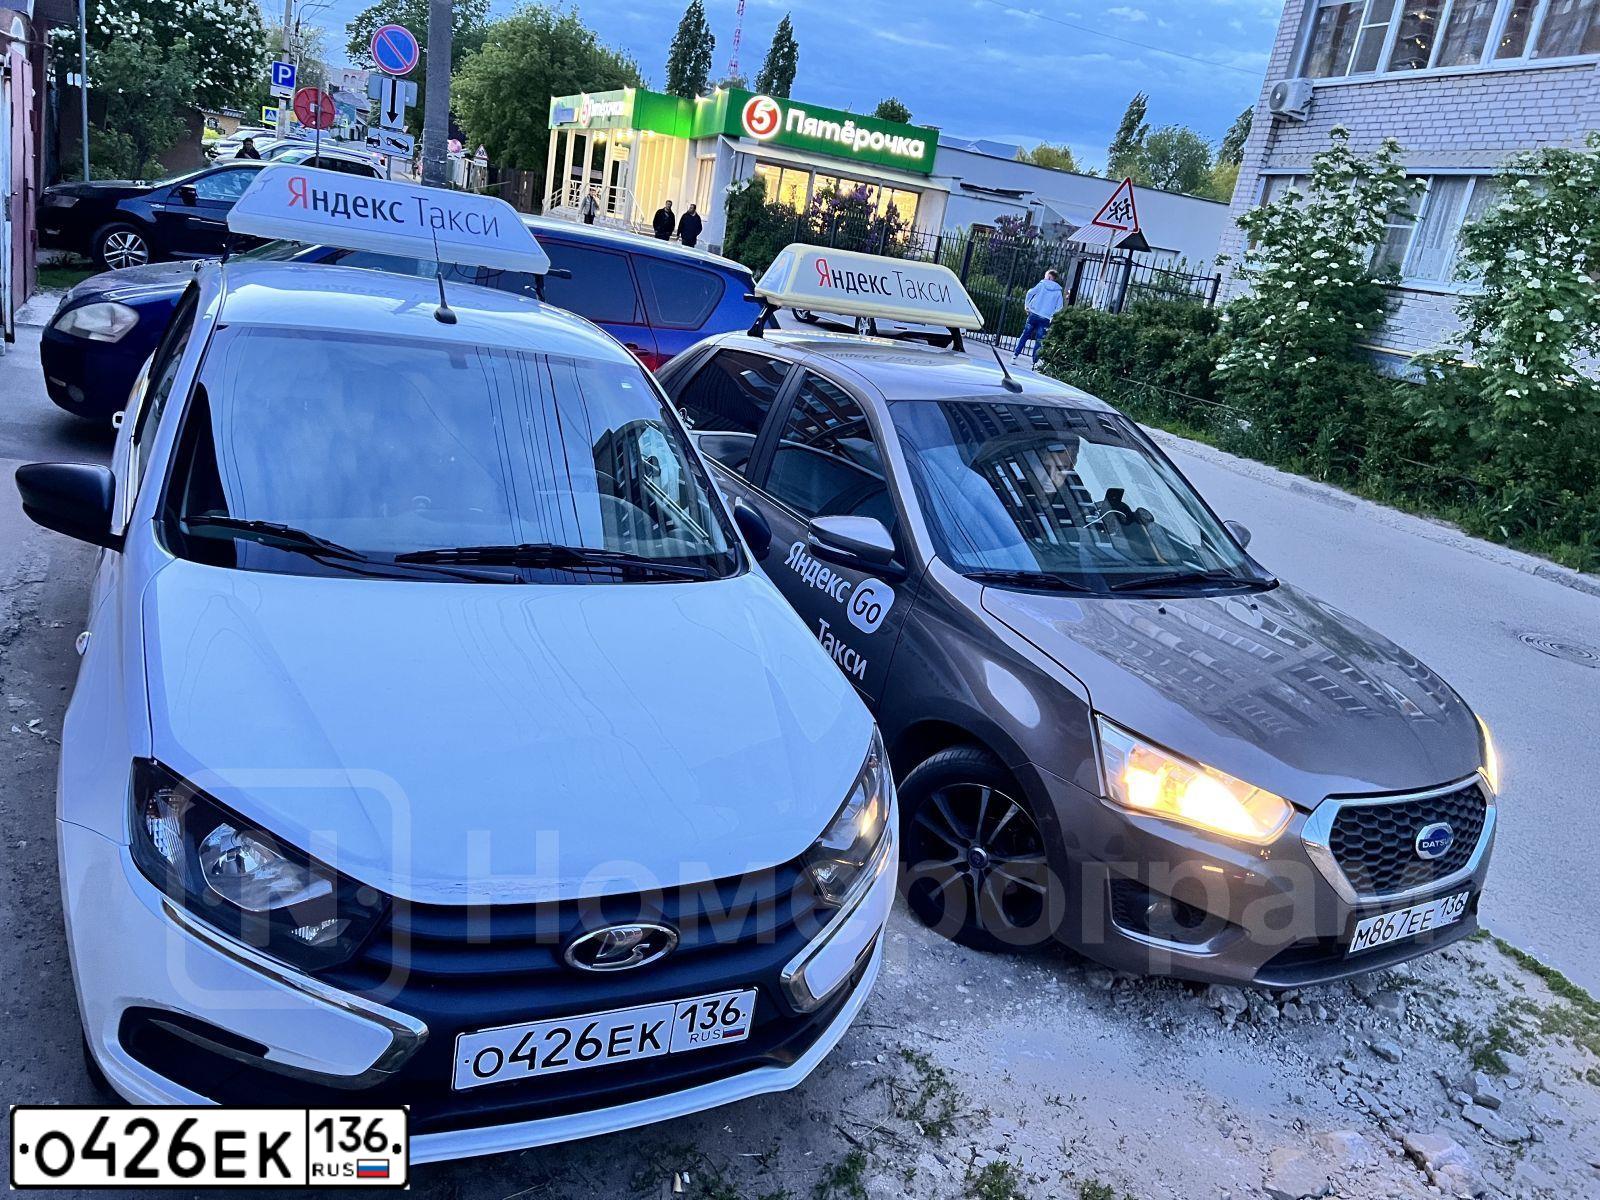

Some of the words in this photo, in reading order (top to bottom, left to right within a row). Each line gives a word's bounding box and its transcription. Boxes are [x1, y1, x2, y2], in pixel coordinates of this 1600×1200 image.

[785, 107, 925, 159] Пятёрочка
[287, 176, 405, 223] Яндекс
[410, 196, 499, 238] Такси
[815, 258, 892, 296] Яндекс
[892, 270, 952, 304] Такси
[784, 541, 851, 603] Яндекс
[853, 588, 882, 624] Go
[817, 617, 868, 681] Такси
[1440, 893, 1464, 917] 136
[679, 996, 741, 1033] 136
[689, 1029, 720, 1045] RUS
